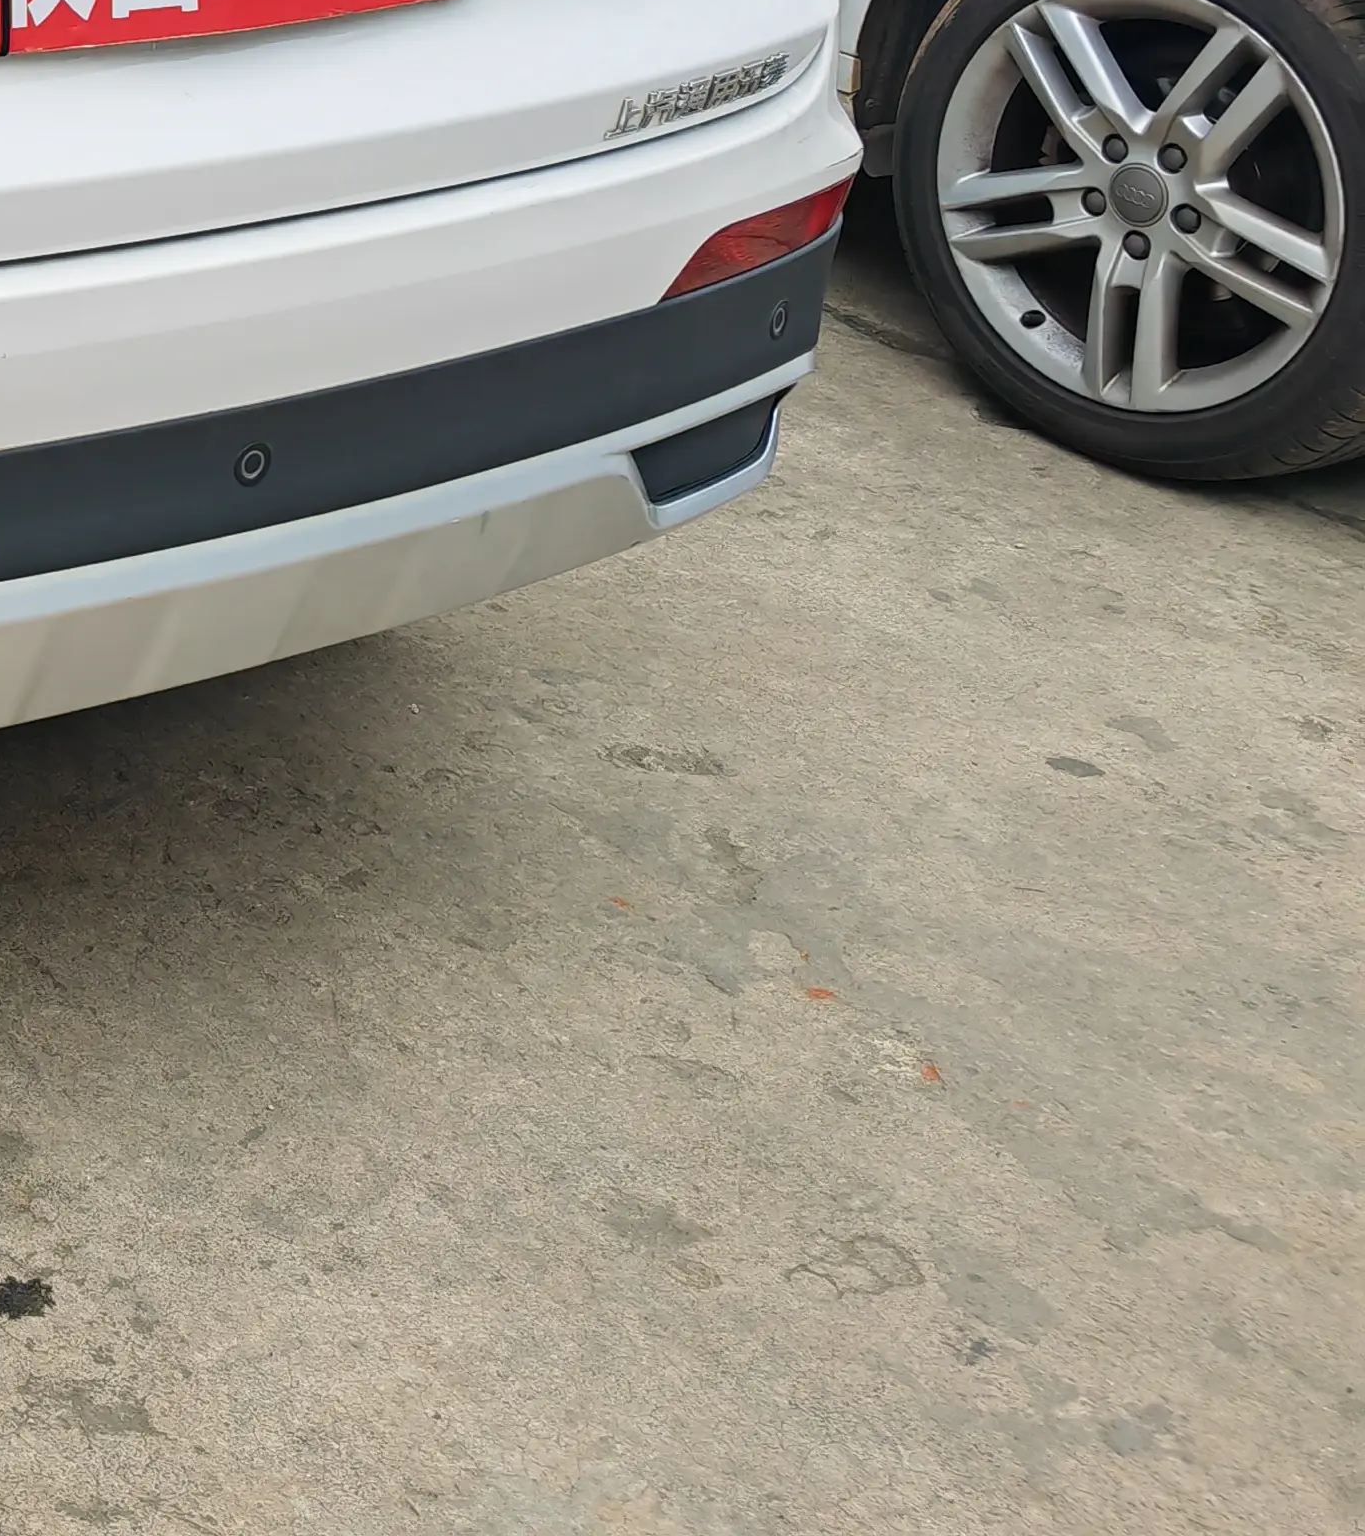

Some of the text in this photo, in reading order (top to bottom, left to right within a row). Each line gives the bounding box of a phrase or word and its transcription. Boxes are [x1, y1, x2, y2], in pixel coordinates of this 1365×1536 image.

[603, 51, 790, 141] 上汽通用五菱
